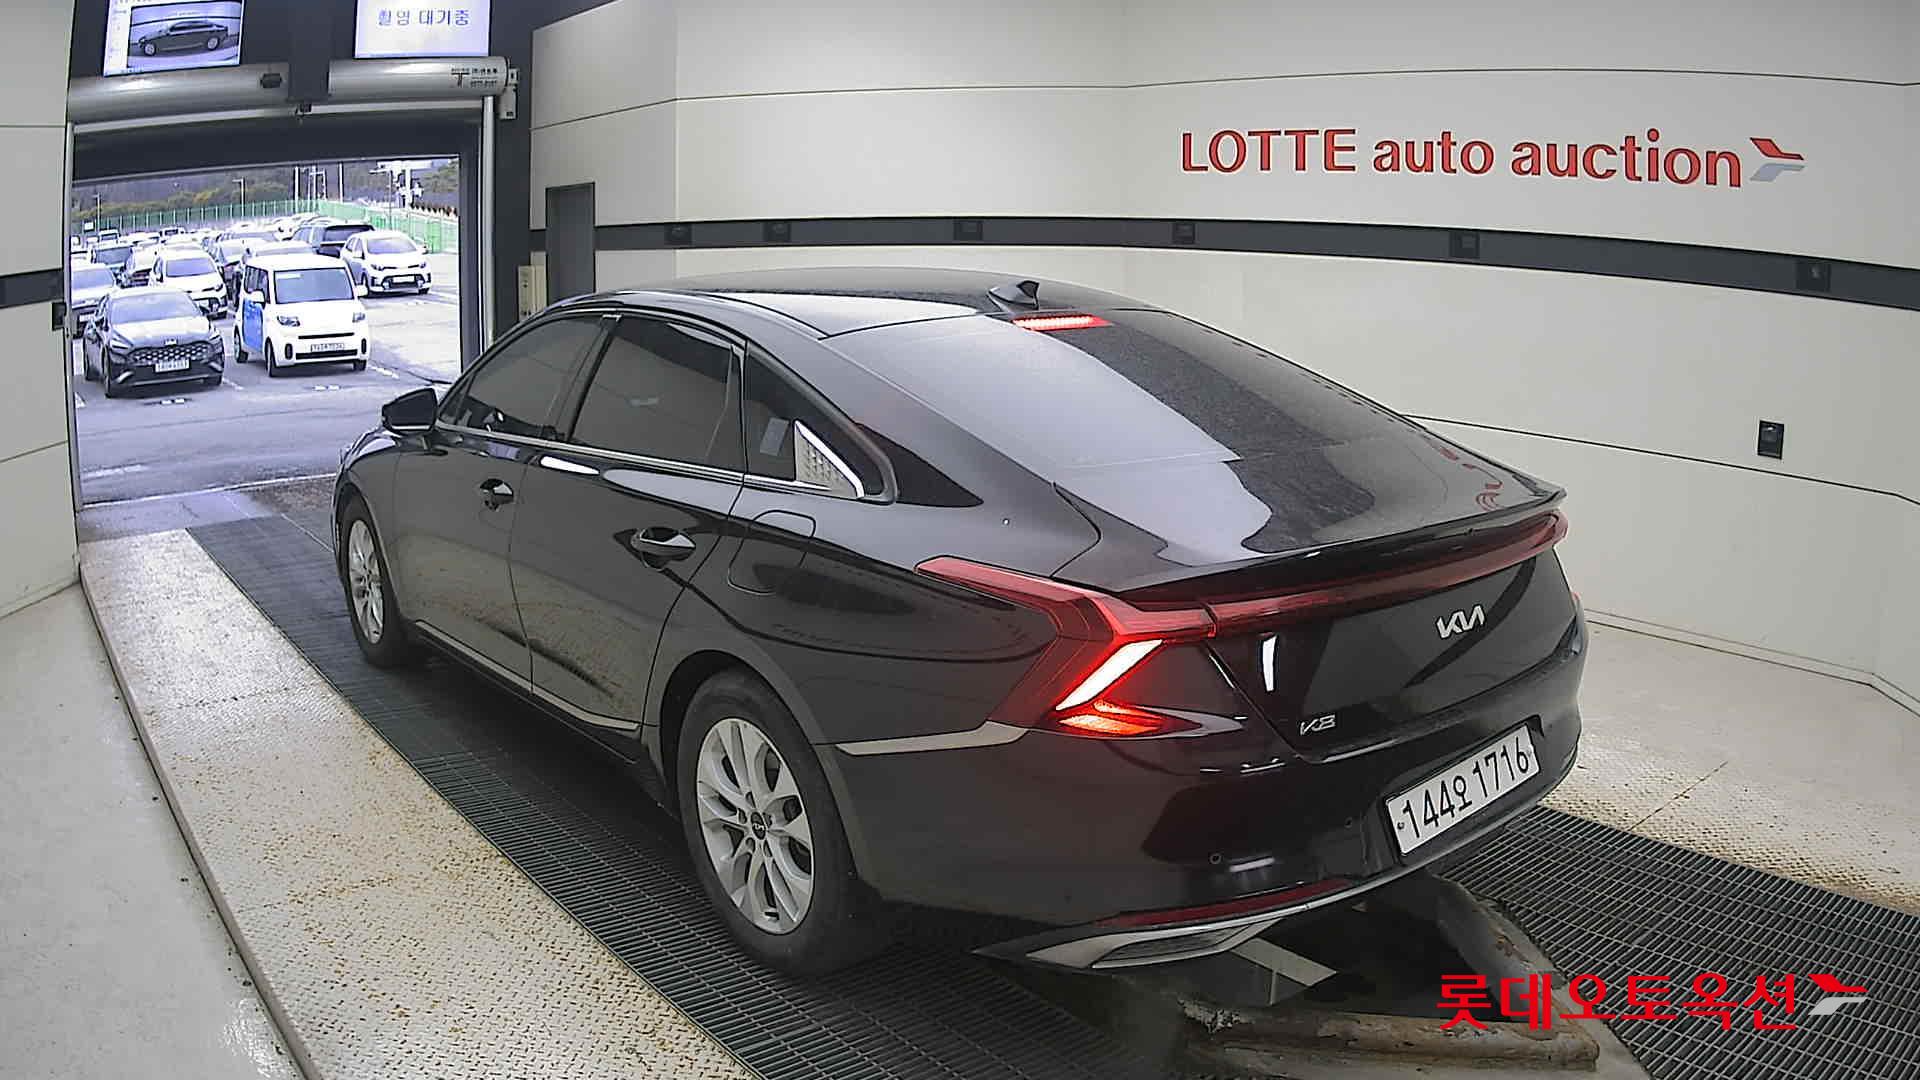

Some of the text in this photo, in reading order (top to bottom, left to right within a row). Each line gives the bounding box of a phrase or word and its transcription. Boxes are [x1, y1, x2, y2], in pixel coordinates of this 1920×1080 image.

[419, 9, 469, 26] 대기중
[1182, 128, 1741, 187] LOTTE auto auction
[1435, 605, 1486, 638] KIA
[1299, 714, 1336, 735] K8
[1402, 736, 1530, 839] 144오 1716
